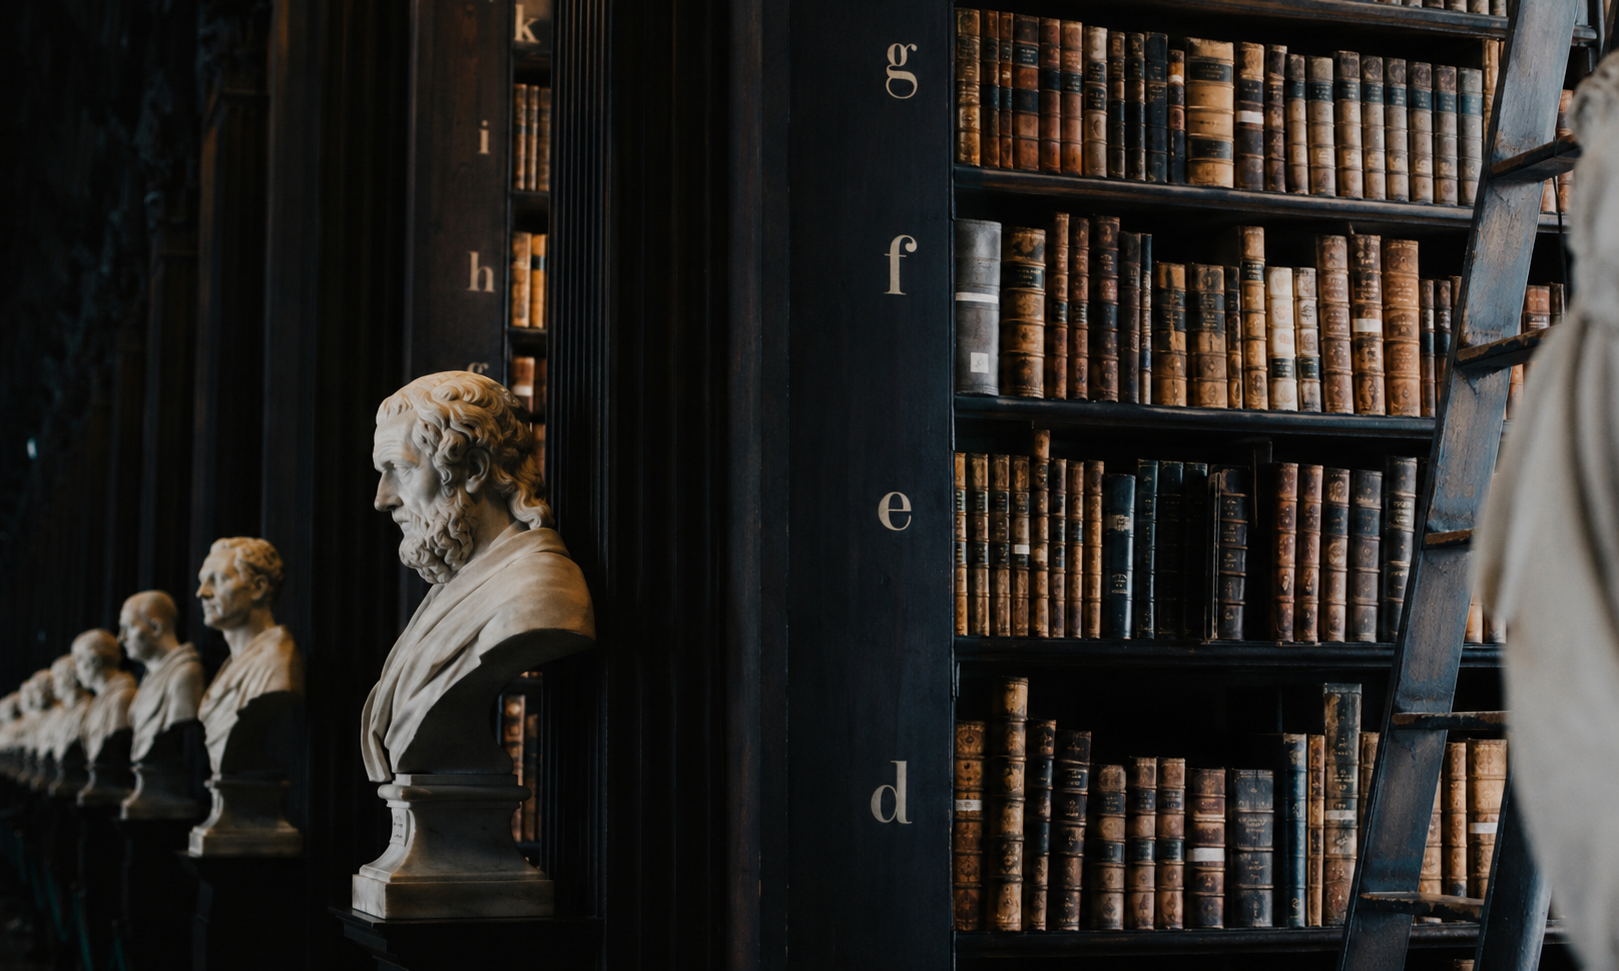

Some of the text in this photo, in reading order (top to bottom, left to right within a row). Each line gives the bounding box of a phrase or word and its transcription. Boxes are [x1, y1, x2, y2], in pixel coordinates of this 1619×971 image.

[514, 4, 541, 44] k
[885, 43, 918, 99] g
[478, 120, 490, 155] i
[468, 251, 496, 293] h
[884, 234, 918, 295] f
[878, 491, 912, 531] e
[870, 760, 912, 824] d
